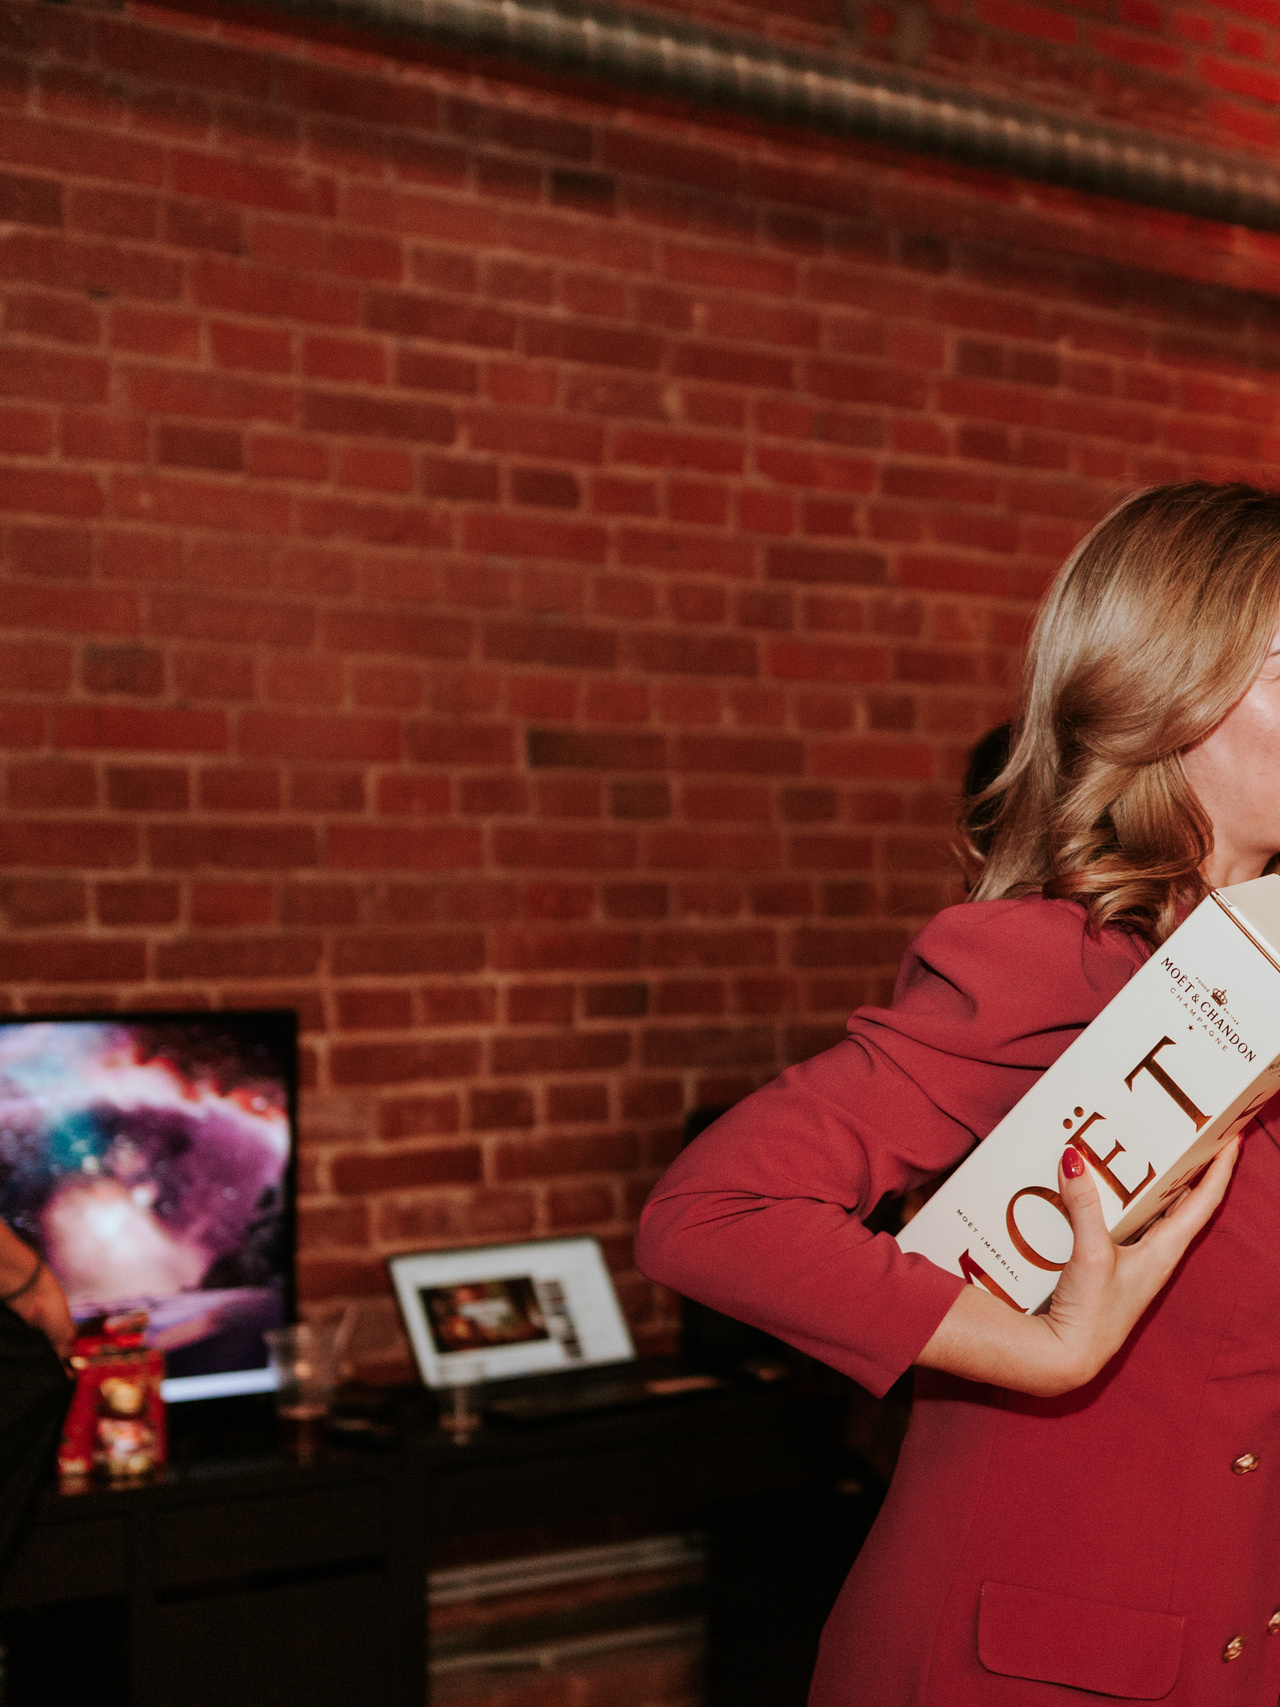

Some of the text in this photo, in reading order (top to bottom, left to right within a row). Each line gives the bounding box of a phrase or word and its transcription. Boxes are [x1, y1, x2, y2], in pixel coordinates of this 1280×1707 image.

[1160, 957, 1257, 1063] MOËT & CHANDON
[1169, 987, 1229, 1052] CHAMPAGNE
